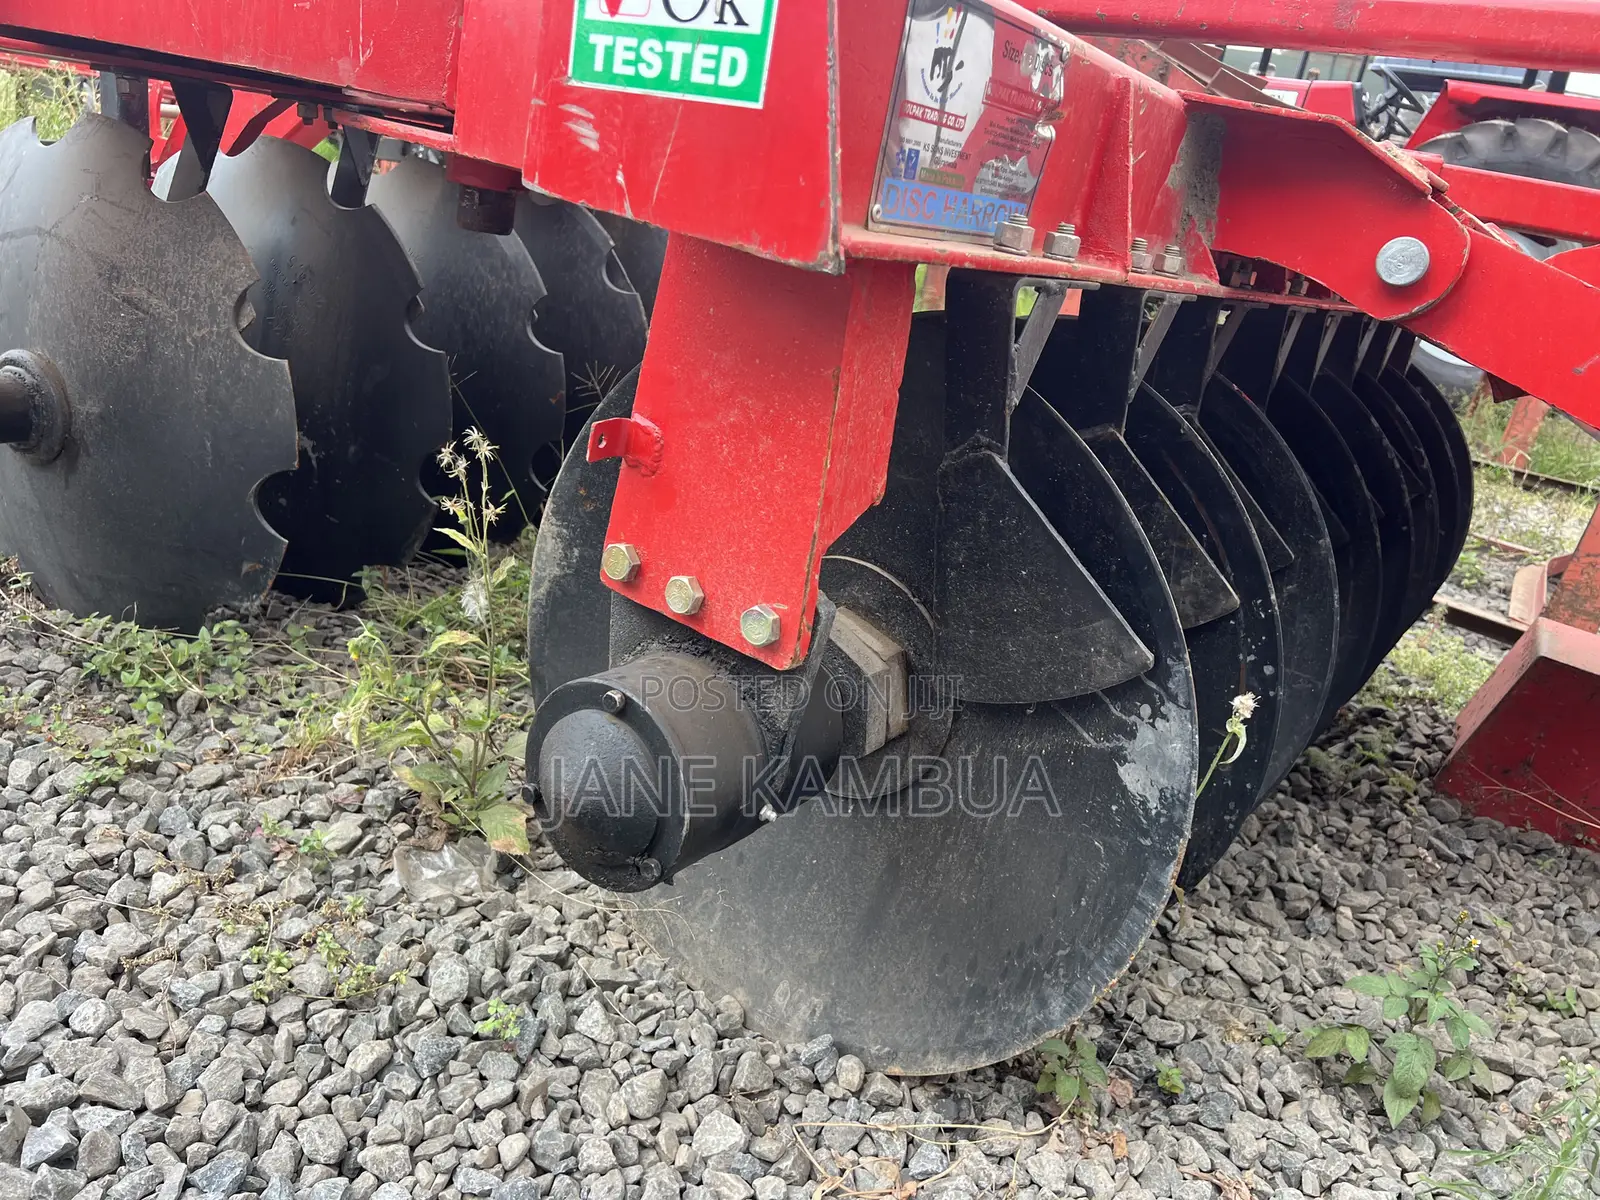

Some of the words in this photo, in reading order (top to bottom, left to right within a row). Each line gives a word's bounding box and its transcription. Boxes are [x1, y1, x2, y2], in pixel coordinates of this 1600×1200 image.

[589, 33, 748, 88] TESTED
[924, 106, 947, 124] TRADG
[884, 183, 937, 220] DISC
